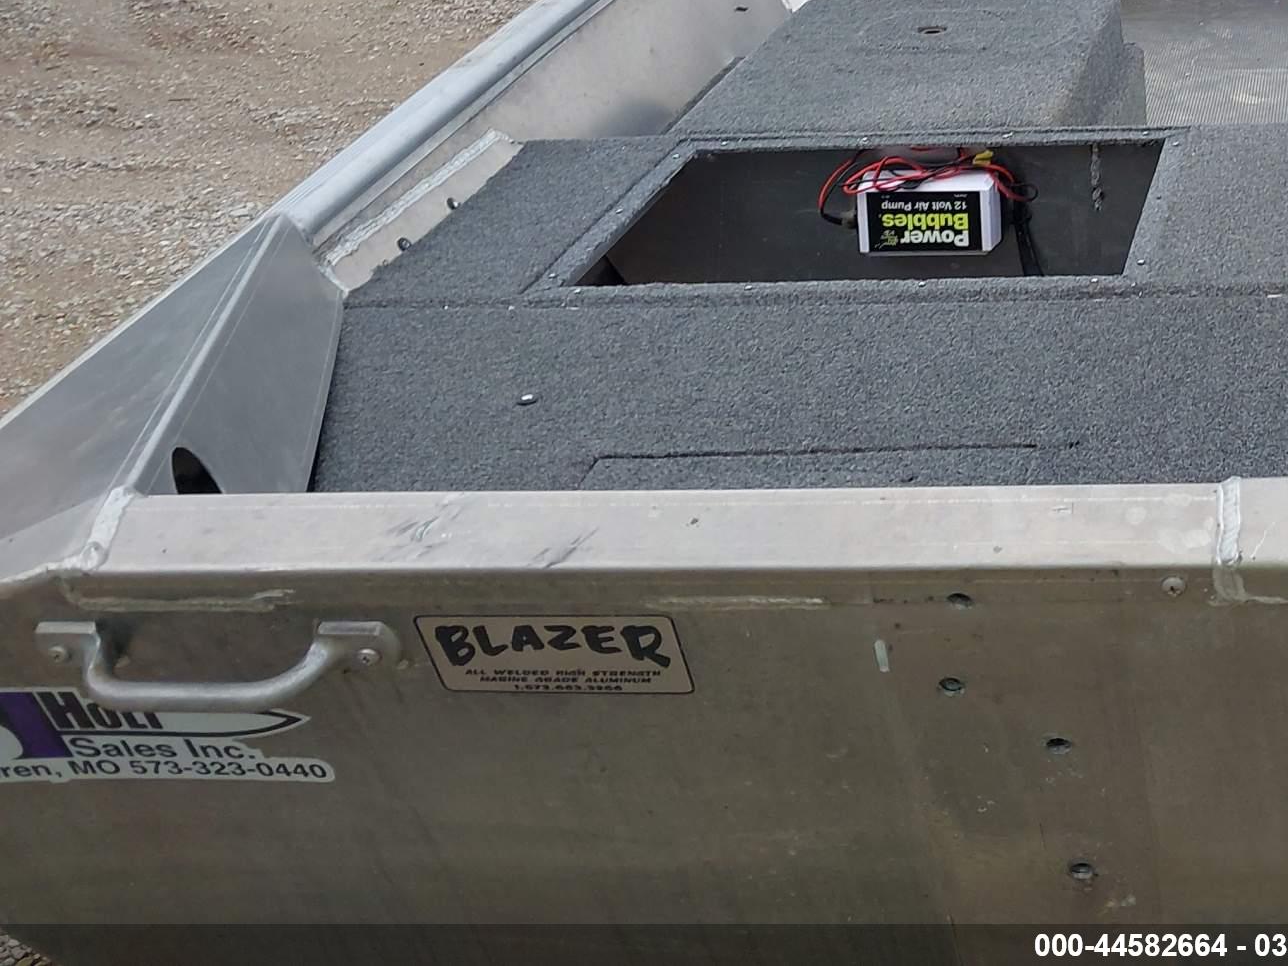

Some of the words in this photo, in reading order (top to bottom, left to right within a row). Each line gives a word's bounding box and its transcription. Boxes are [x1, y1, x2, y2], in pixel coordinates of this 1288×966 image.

[881, 199, 912, 211] Pump
[913, 200, 929, 210] Air
[931, 200, 953, 210] Volt
[953, 200, 968, 210] 12
[882, 213, 969, 230] Bubbles
[901, 231, 969, 247] Power
[434, 624, 672, 669] BLAZER
[464, 668, 487, 676] ALL
[556, 669, 586, 677] HIGH
[70, 737, 178, 759] Sales
[183, 738, 256, 760] Inc.
[67, 760, 121, 775] MO
[130, 760, 328, 780] 573-323-0440
